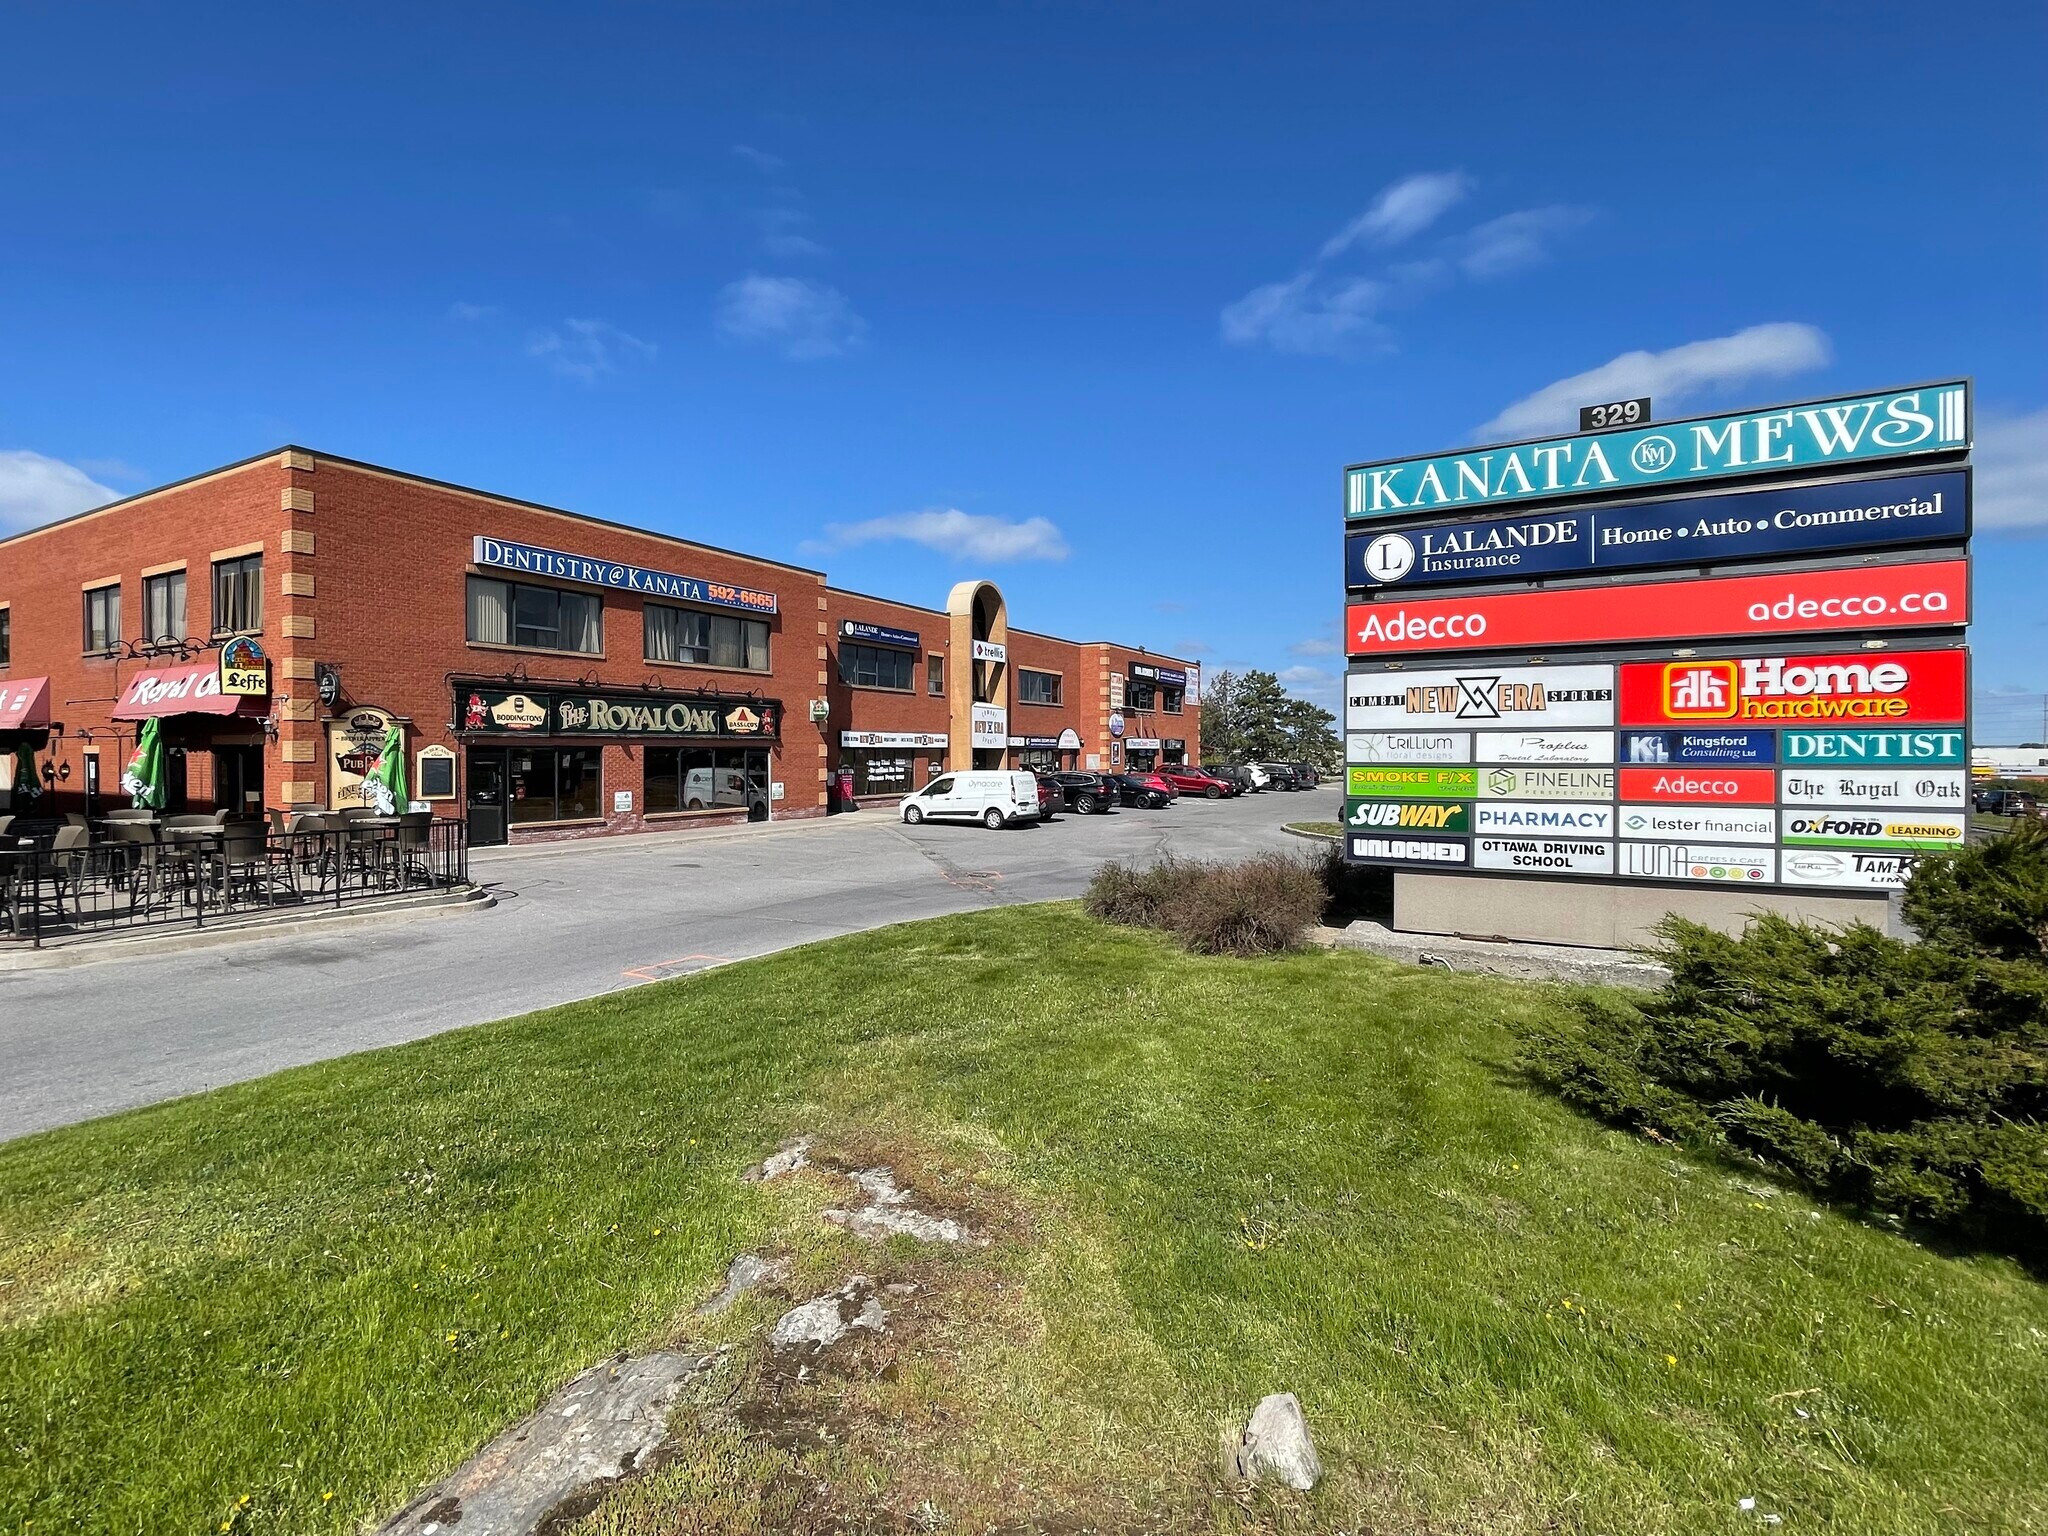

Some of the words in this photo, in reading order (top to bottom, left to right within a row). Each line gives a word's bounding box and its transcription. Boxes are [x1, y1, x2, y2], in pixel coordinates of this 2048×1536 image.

[1591, 401, 1641, 429] 329
[1368, 440, 1621, 512] KANATA
[1690, 392, 1935, 472] MEWS
[1602, 526, 1673, 546] Home
[1692, 517, 1752, 539] Auto
[1774, 492, 1944, 530] Commercial
[1422, 519, 1578, 556] LALANDE
[1422, 552, 1522, 573] Insurance
[483, 539, 606, 583] DENTISTRY
[627, 568, 701, 600] KANATA
[707, 585, 774, 608] 592-6665
[1747, 591, 1949, 621] adecco.ca
[1357, 610, 1487, 643] Adecco
[984, 645, 1004, 659] trellis
[226, 672, 266, 691] Leffe
[1740, 658, 1909, 697] Home
[129, 673, 196, 705] Royal
[1350, 695, 1405, 707] COMBAT
[1406, 686, 1459, 713] NEW
[1497, 683, 1547, 712] ERA
[1551, 689, 1609, 702] SPORTS
[588, 699, 668, 732] ROYAL
[667, 703, 717, 732] OAK
[1741, 695, 1909, 720] hardware
[496, 713, 543, 723] BODDINGTONS
[1520, 737, 1589, 752] Proplus
[1683, 736, 1748, 748] Kingsford
[1787, 733, 1962, 758] DENTIST
[1387, 750, 1415, 760] floral
[1416, 750, 1453, 761] designs
[1535, 754, 1589, 762] Laboratory
[1682, 747, 1741, 759] Consulting
[343, 758, 364, 769] PUB
[1352, 771, 1430, 783] SMOKE
[1437, 772, 1474, 784] F/X
[1525, 771, 1614, 788] FINELINE
[1652, 776, 1739, 795] Adecco
[1525, 789, 1613, 797] PERSPECTIVES
[1787, 778, 1825, 799] The
[1839, 777, 1900, 797] Royal
[1915, 778, 1962, 798] Oak
[1349, 803, 1463, 828] SUBWAY
[1479, 810, 1608, 828] PHARMACY
[1652, 816, 1701, 831] lester
[1705, 819, 1773, 834] financial
[1790, 818, 1883, 836] OXFORD
[1892, 826, 1956, 837] LEARNING
[1353, 838, 1466, 862] UNLOCKED
[1482, 840, 1538, 854] OTTAWA
[1543, 842, 1606, 856] DRIVING
[1512, 855, 1573, 868] SCHOOL
